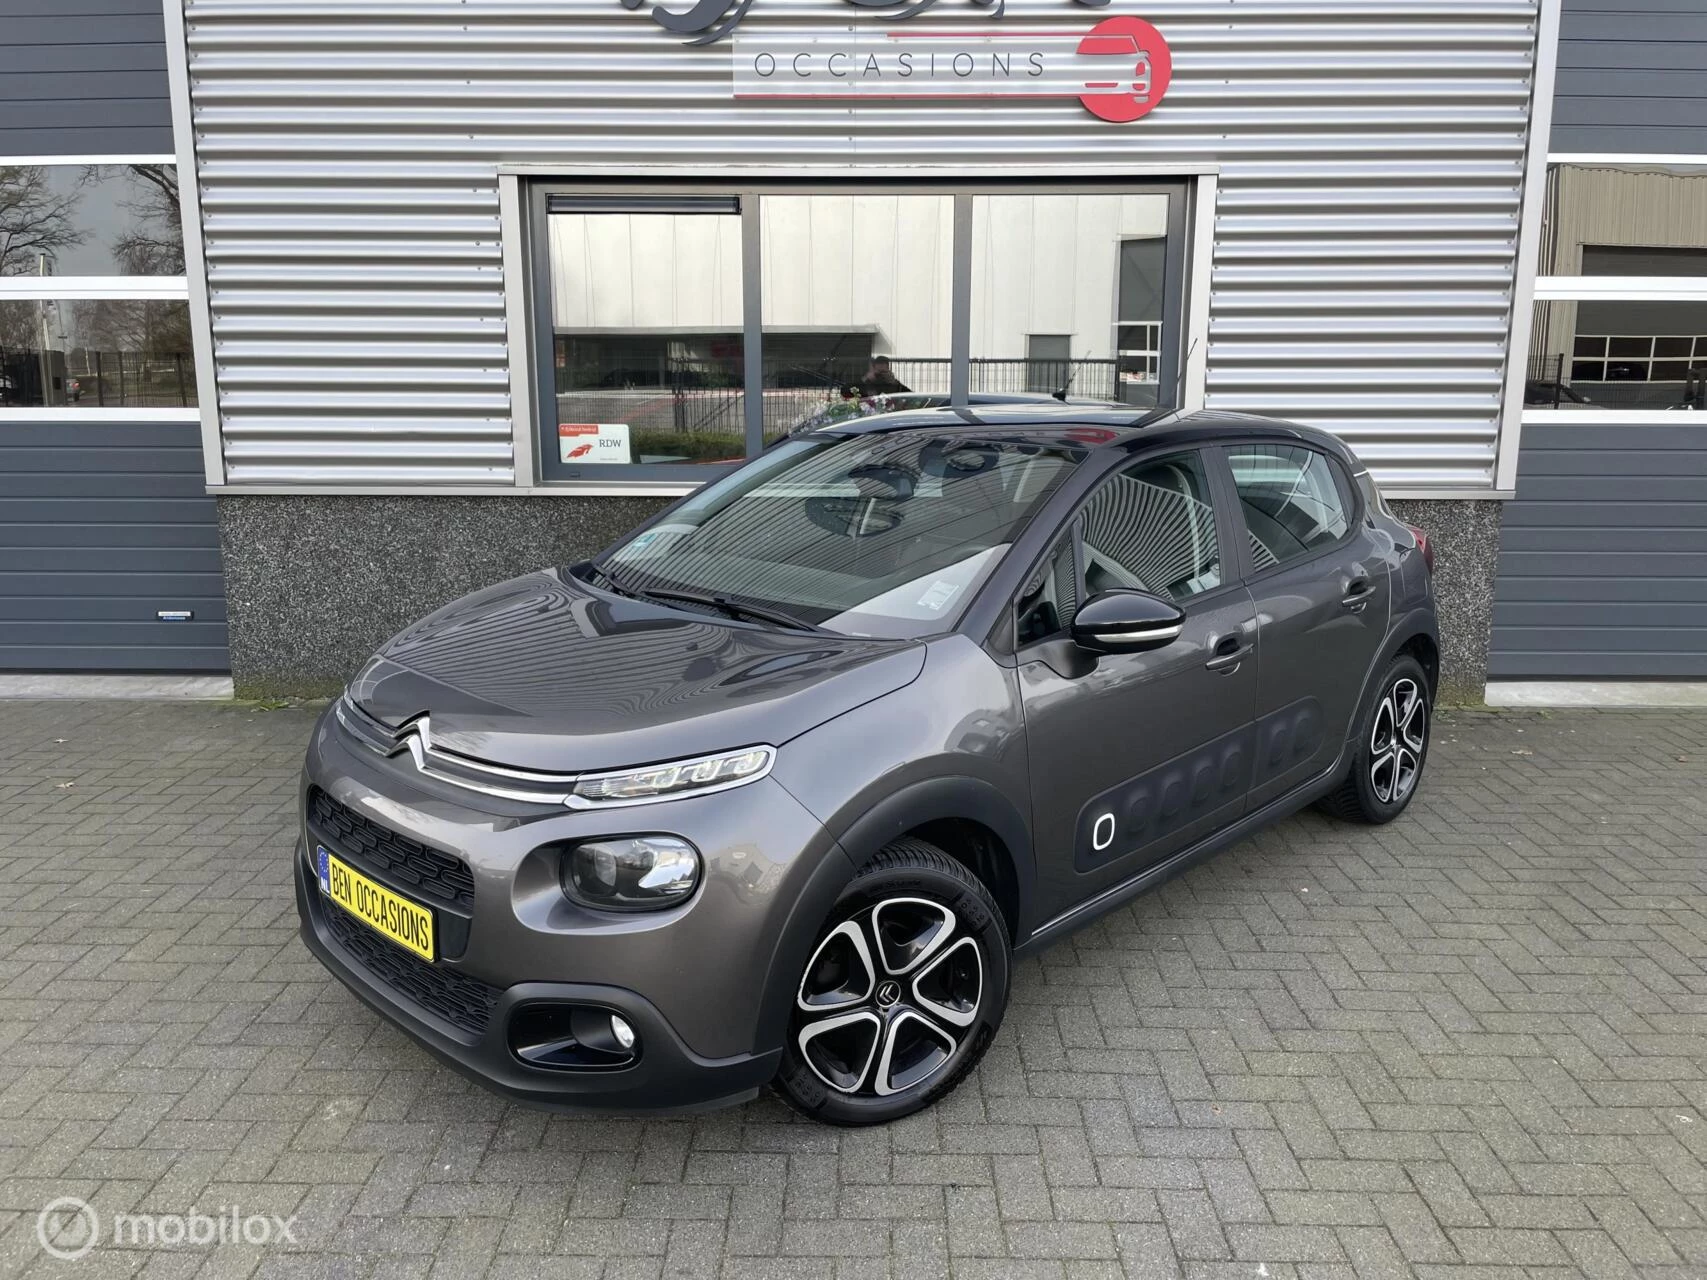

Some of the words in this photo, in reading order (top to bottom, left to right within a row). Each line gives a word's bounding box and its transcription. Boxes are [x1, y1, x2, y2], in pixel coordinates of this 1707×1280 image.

[754, 52, 1045, 78] OCCASIONS
[599, 439, 622, 448] RDW
[320, 877, 331, 894] NL
[332, 861, 352, 906] BEN
[356, 879, 429, 951] OCCASIONS
